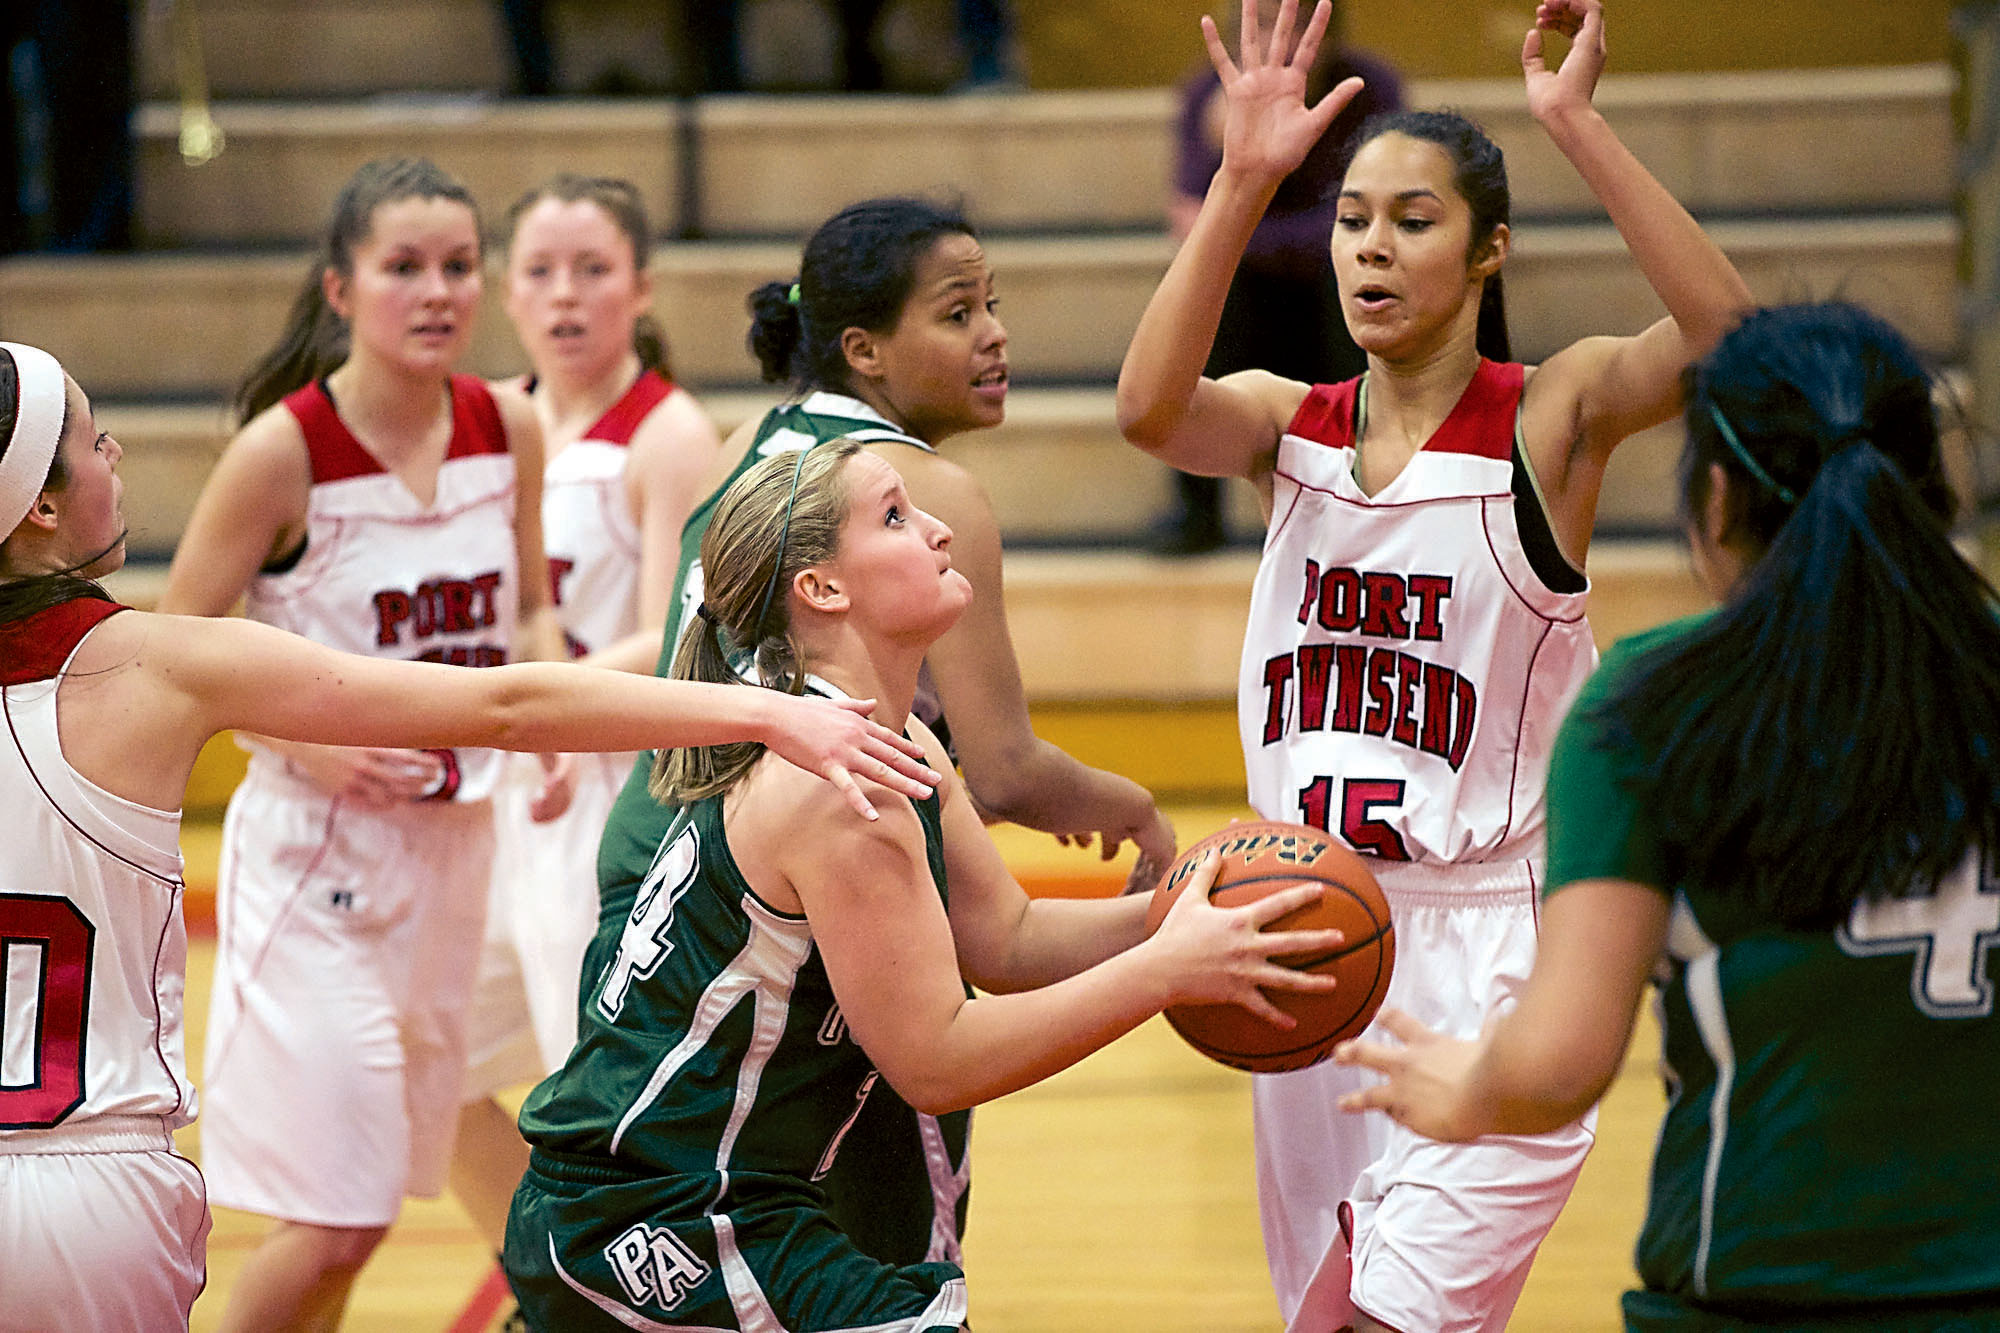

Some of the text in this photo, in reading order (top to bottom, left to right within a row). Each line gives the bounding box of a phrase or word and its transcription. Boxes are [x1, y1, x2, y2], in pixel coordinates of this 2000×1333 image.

[371, 570, 503, 648] PORT
[1262, 642, 1478, 774] TWNSEND
[1299, 775, 1412, 861] 15
[604, 1222, 712, 1313] PA
